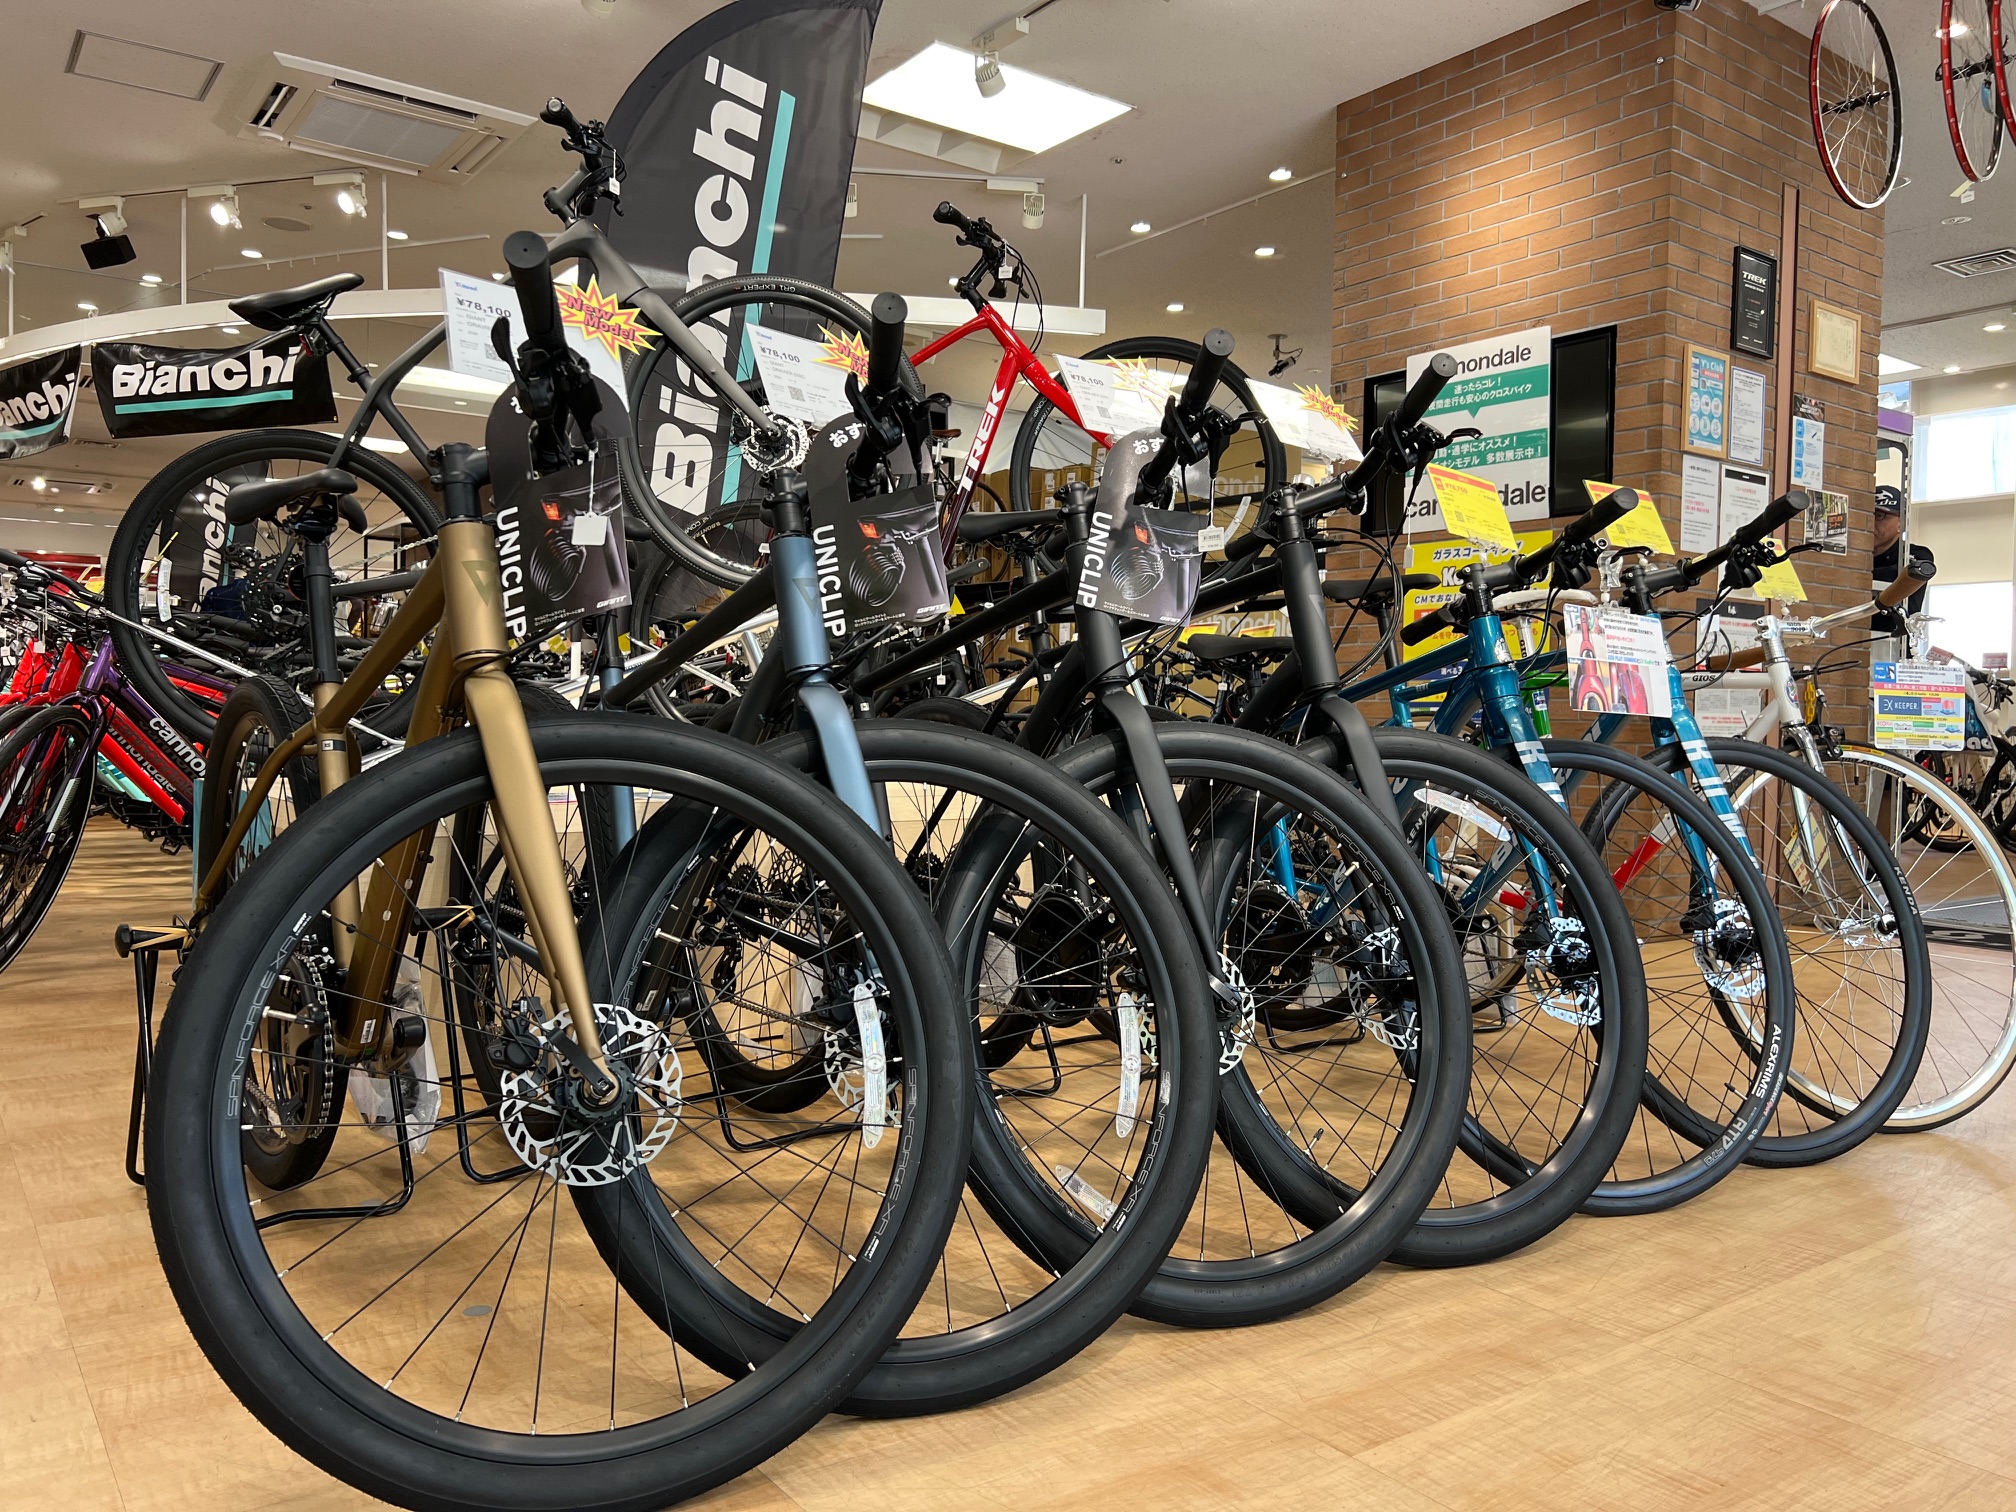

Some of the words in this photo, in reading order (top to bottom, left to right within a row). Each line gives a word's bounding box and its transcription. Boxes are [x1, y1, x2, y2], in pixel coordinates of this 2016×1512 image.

[650, 54, 768, 516] Bianchi
[1742, 271, 1767, 286] TREK
[456, 297, 511, 318] ¥78,100
[567, 294, 614, 320] New
[584, 316, 636, 341] Model
[759, 346, 800, 363] ¥78,100
[1457, 347, 1531, 374] nondale
[1710, 361, 1724, 373] Club
[112, 346, 303, 397] Bianchi
[1070, 373, 1104, 388] ¥78,100
[1454, 376, 1502, 394] 迷ったらコレ！
[0, 373, 75, 427] anchi
[957, 382, 1006, 495] TREK
[1486, 446, 1543, 463] 多数展示中！
[497, 506, 527, 638] UNICLIP
[1082, 511, 1113, 609] UNICLIP
[812, 524, 847, 637] UNICLIP
[596, 595, 627, 608] GIANT
[917, 603, 947, 614] GIANT
[1519, 639, 1528, 657] GIO
[1692, 674, 1716, 682] GIOS
[1894, 702, 1919, 710] KEEPER
[1476, 789, 1545, 844] SPINFORCE
[1312, 810, 1383, 883] SPINFORCE
[1893, 865, 1919, 915] KENDA
[227, 970, 277, 1116] SPINFORCE
[269, 935, 297, 970] XR
[1755, 1023, 1782, 1099] ALEXRIMS
[890, 1068, 918, 1202] SPINFORCE
[875, 1202, 896, 1236] XR
